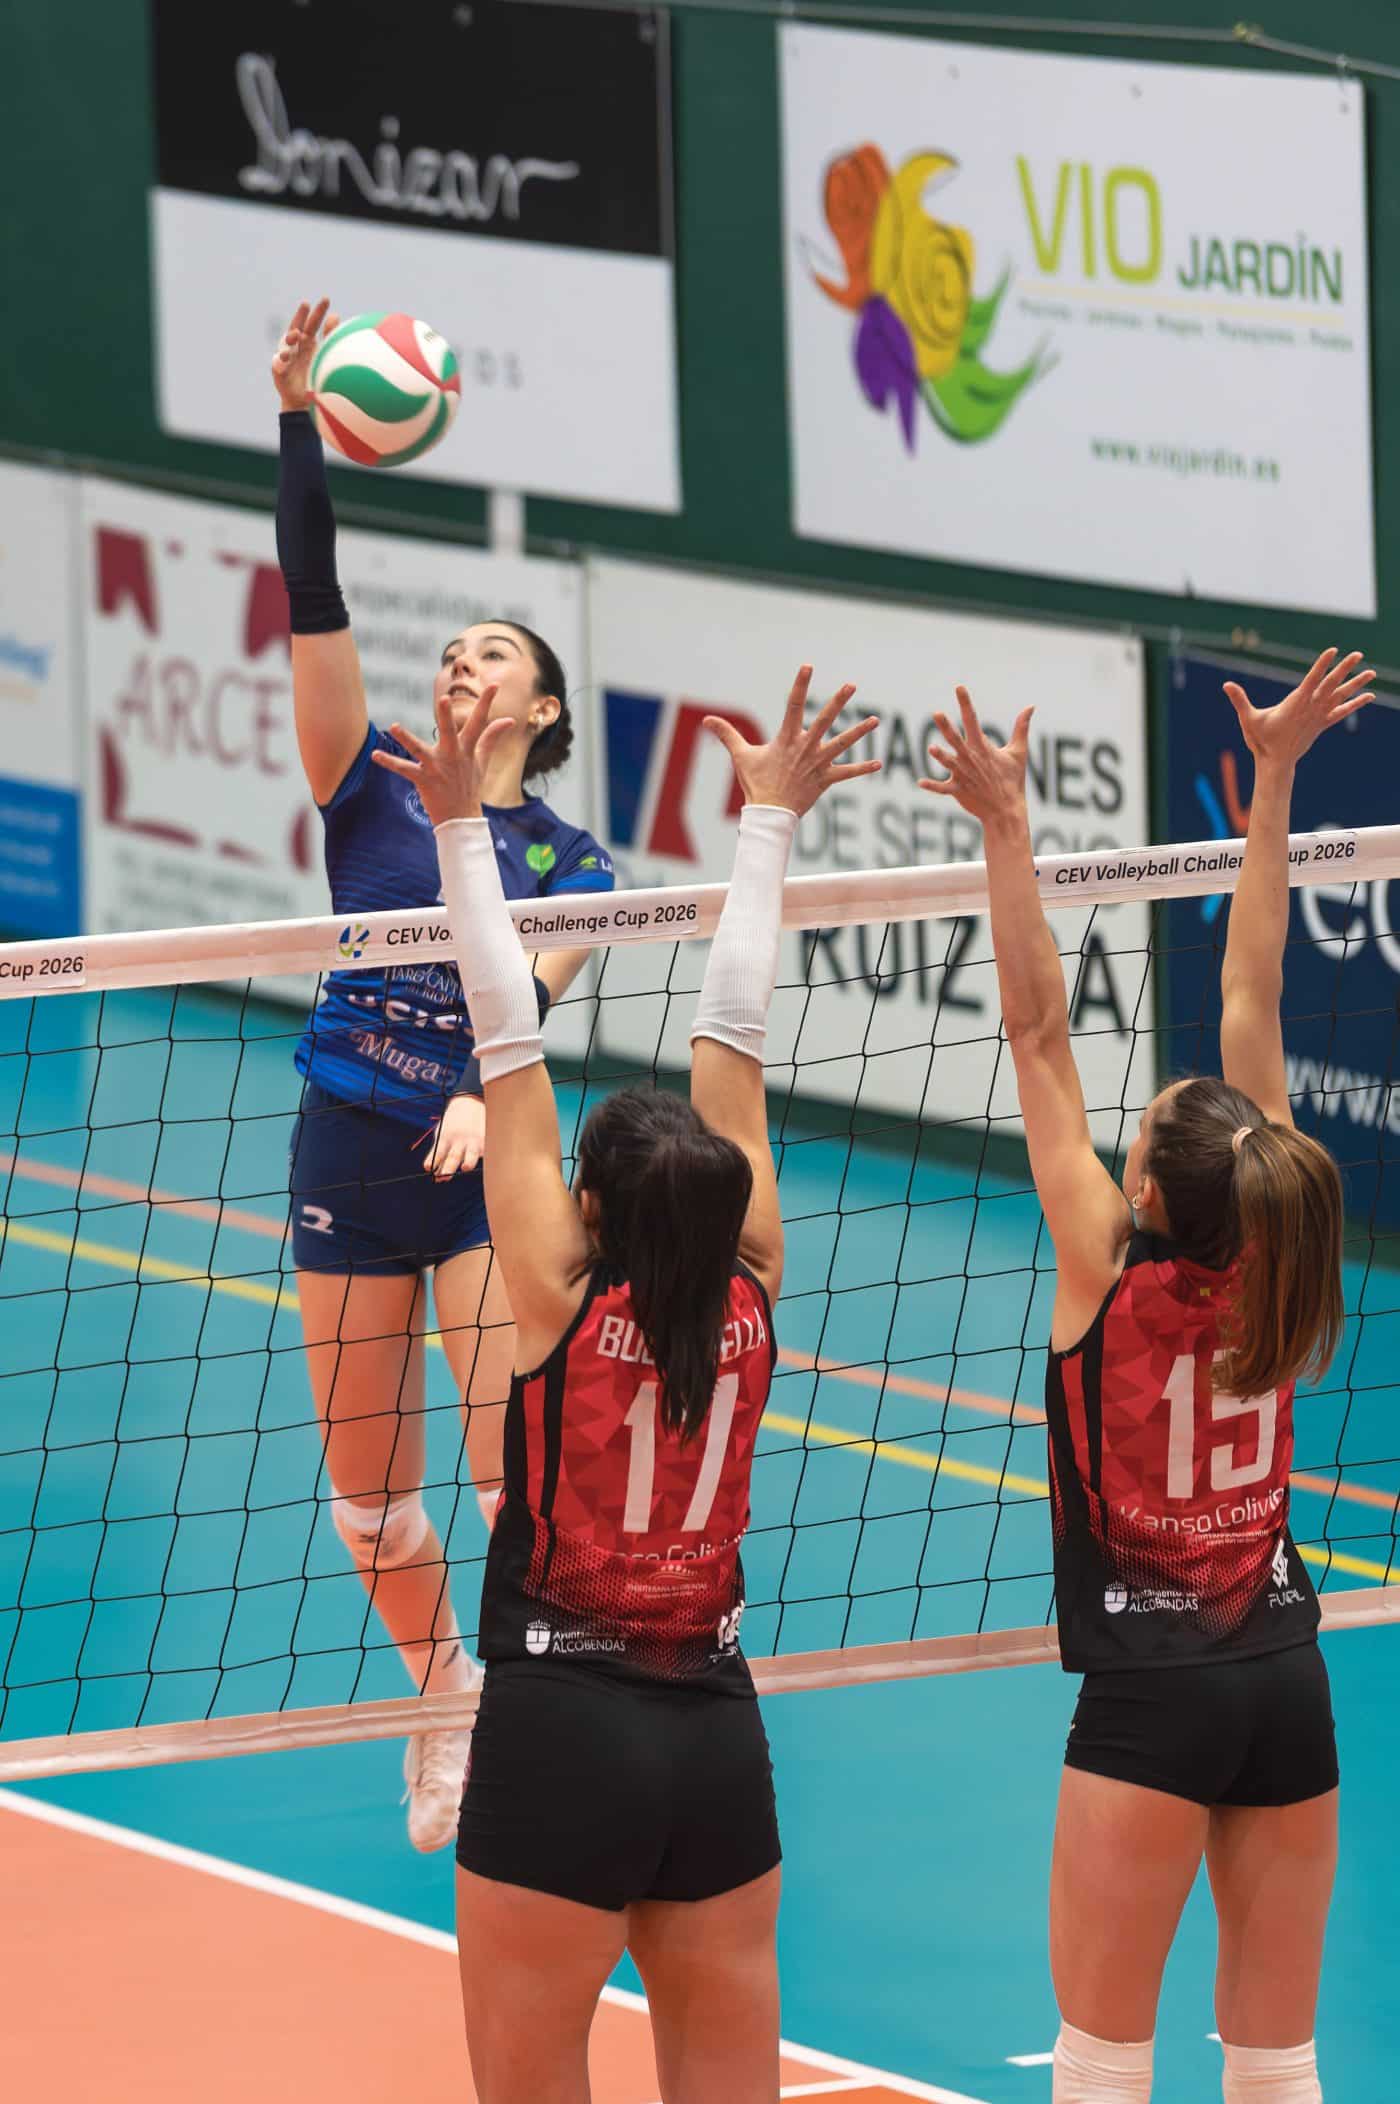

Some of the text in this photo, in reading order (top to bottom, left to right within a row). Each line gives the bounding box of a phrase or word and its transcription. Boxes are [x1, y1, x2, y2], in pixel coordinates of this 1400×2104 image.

[1016, 155, 1162, 284] VIO
[1056, 866, 1092, 884] CEV
[1096, 858, 1178, 882] Volleyball
[1288, 850, 1309, 866] up
[1314, 841, 1356, 860] 2026
[386, 928, 423, 946] CEV
[519, 904, 697, 935] Challenge Cup 2026
[0, 956, 84, 981] Cup 2026
[802, 915, 986, 1014] RUIZ
[1161, 1351, 1277, 1499] 15
[623, 1373, 739, 1533] 17
[1128, 1598, 1199, 1613] ALCOBENDAS
[552, 1639, 626, 1654] ALCOBENDAS
